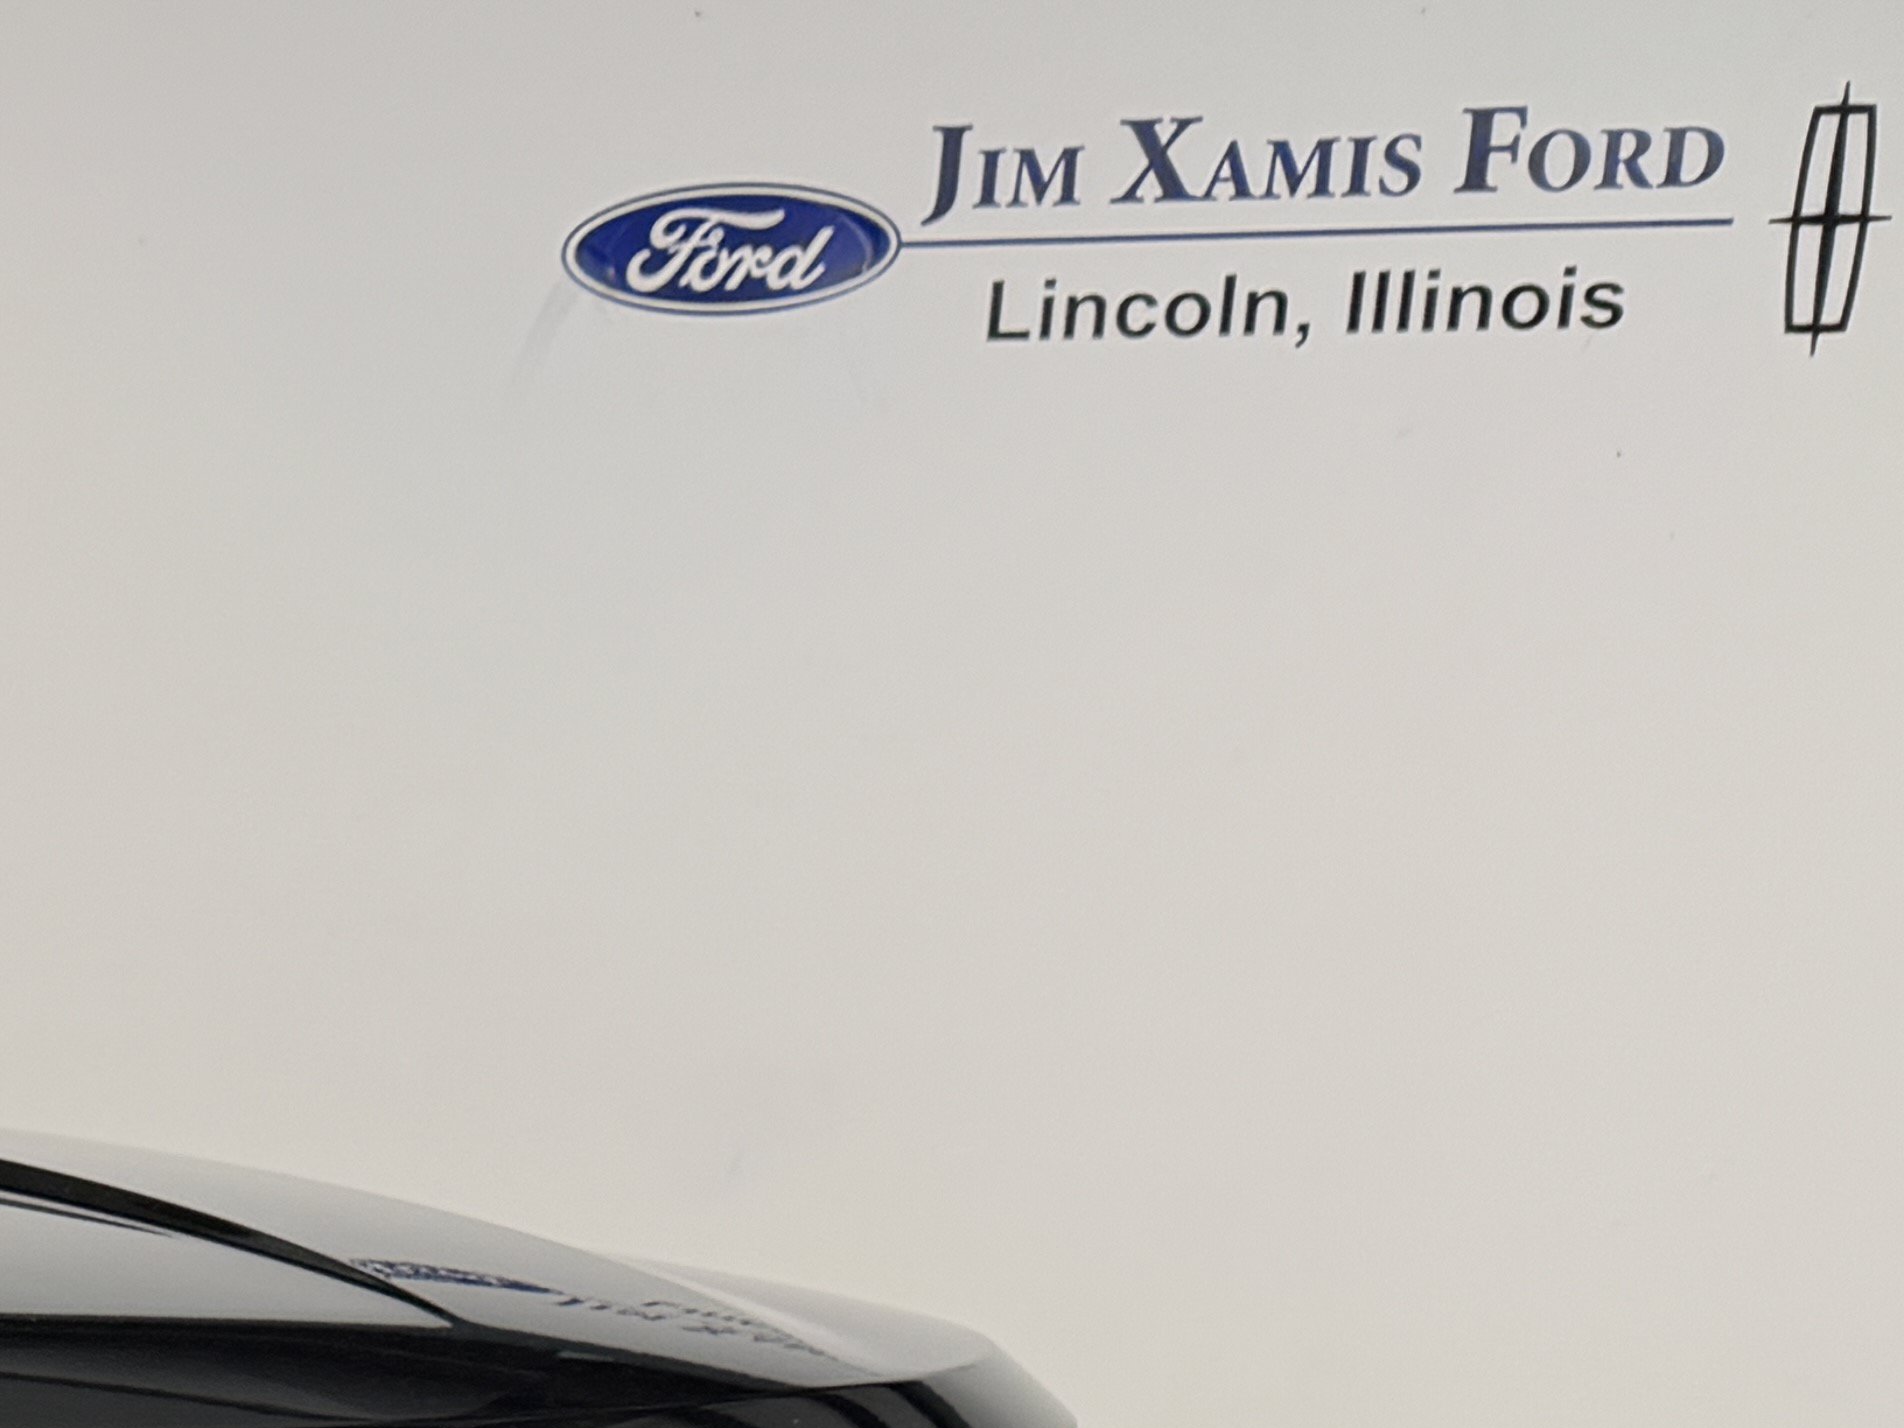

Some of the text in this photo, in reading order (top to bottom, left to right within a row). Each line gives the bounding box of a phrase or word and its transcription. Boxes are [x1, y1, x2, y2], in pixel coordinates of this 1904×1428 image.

[920, 104, 1726, 227] JIM XAMIS FORD
[625, 206, 835, 293] Ford
[986, 264, 1626, 349] Lincoln, Illinois
